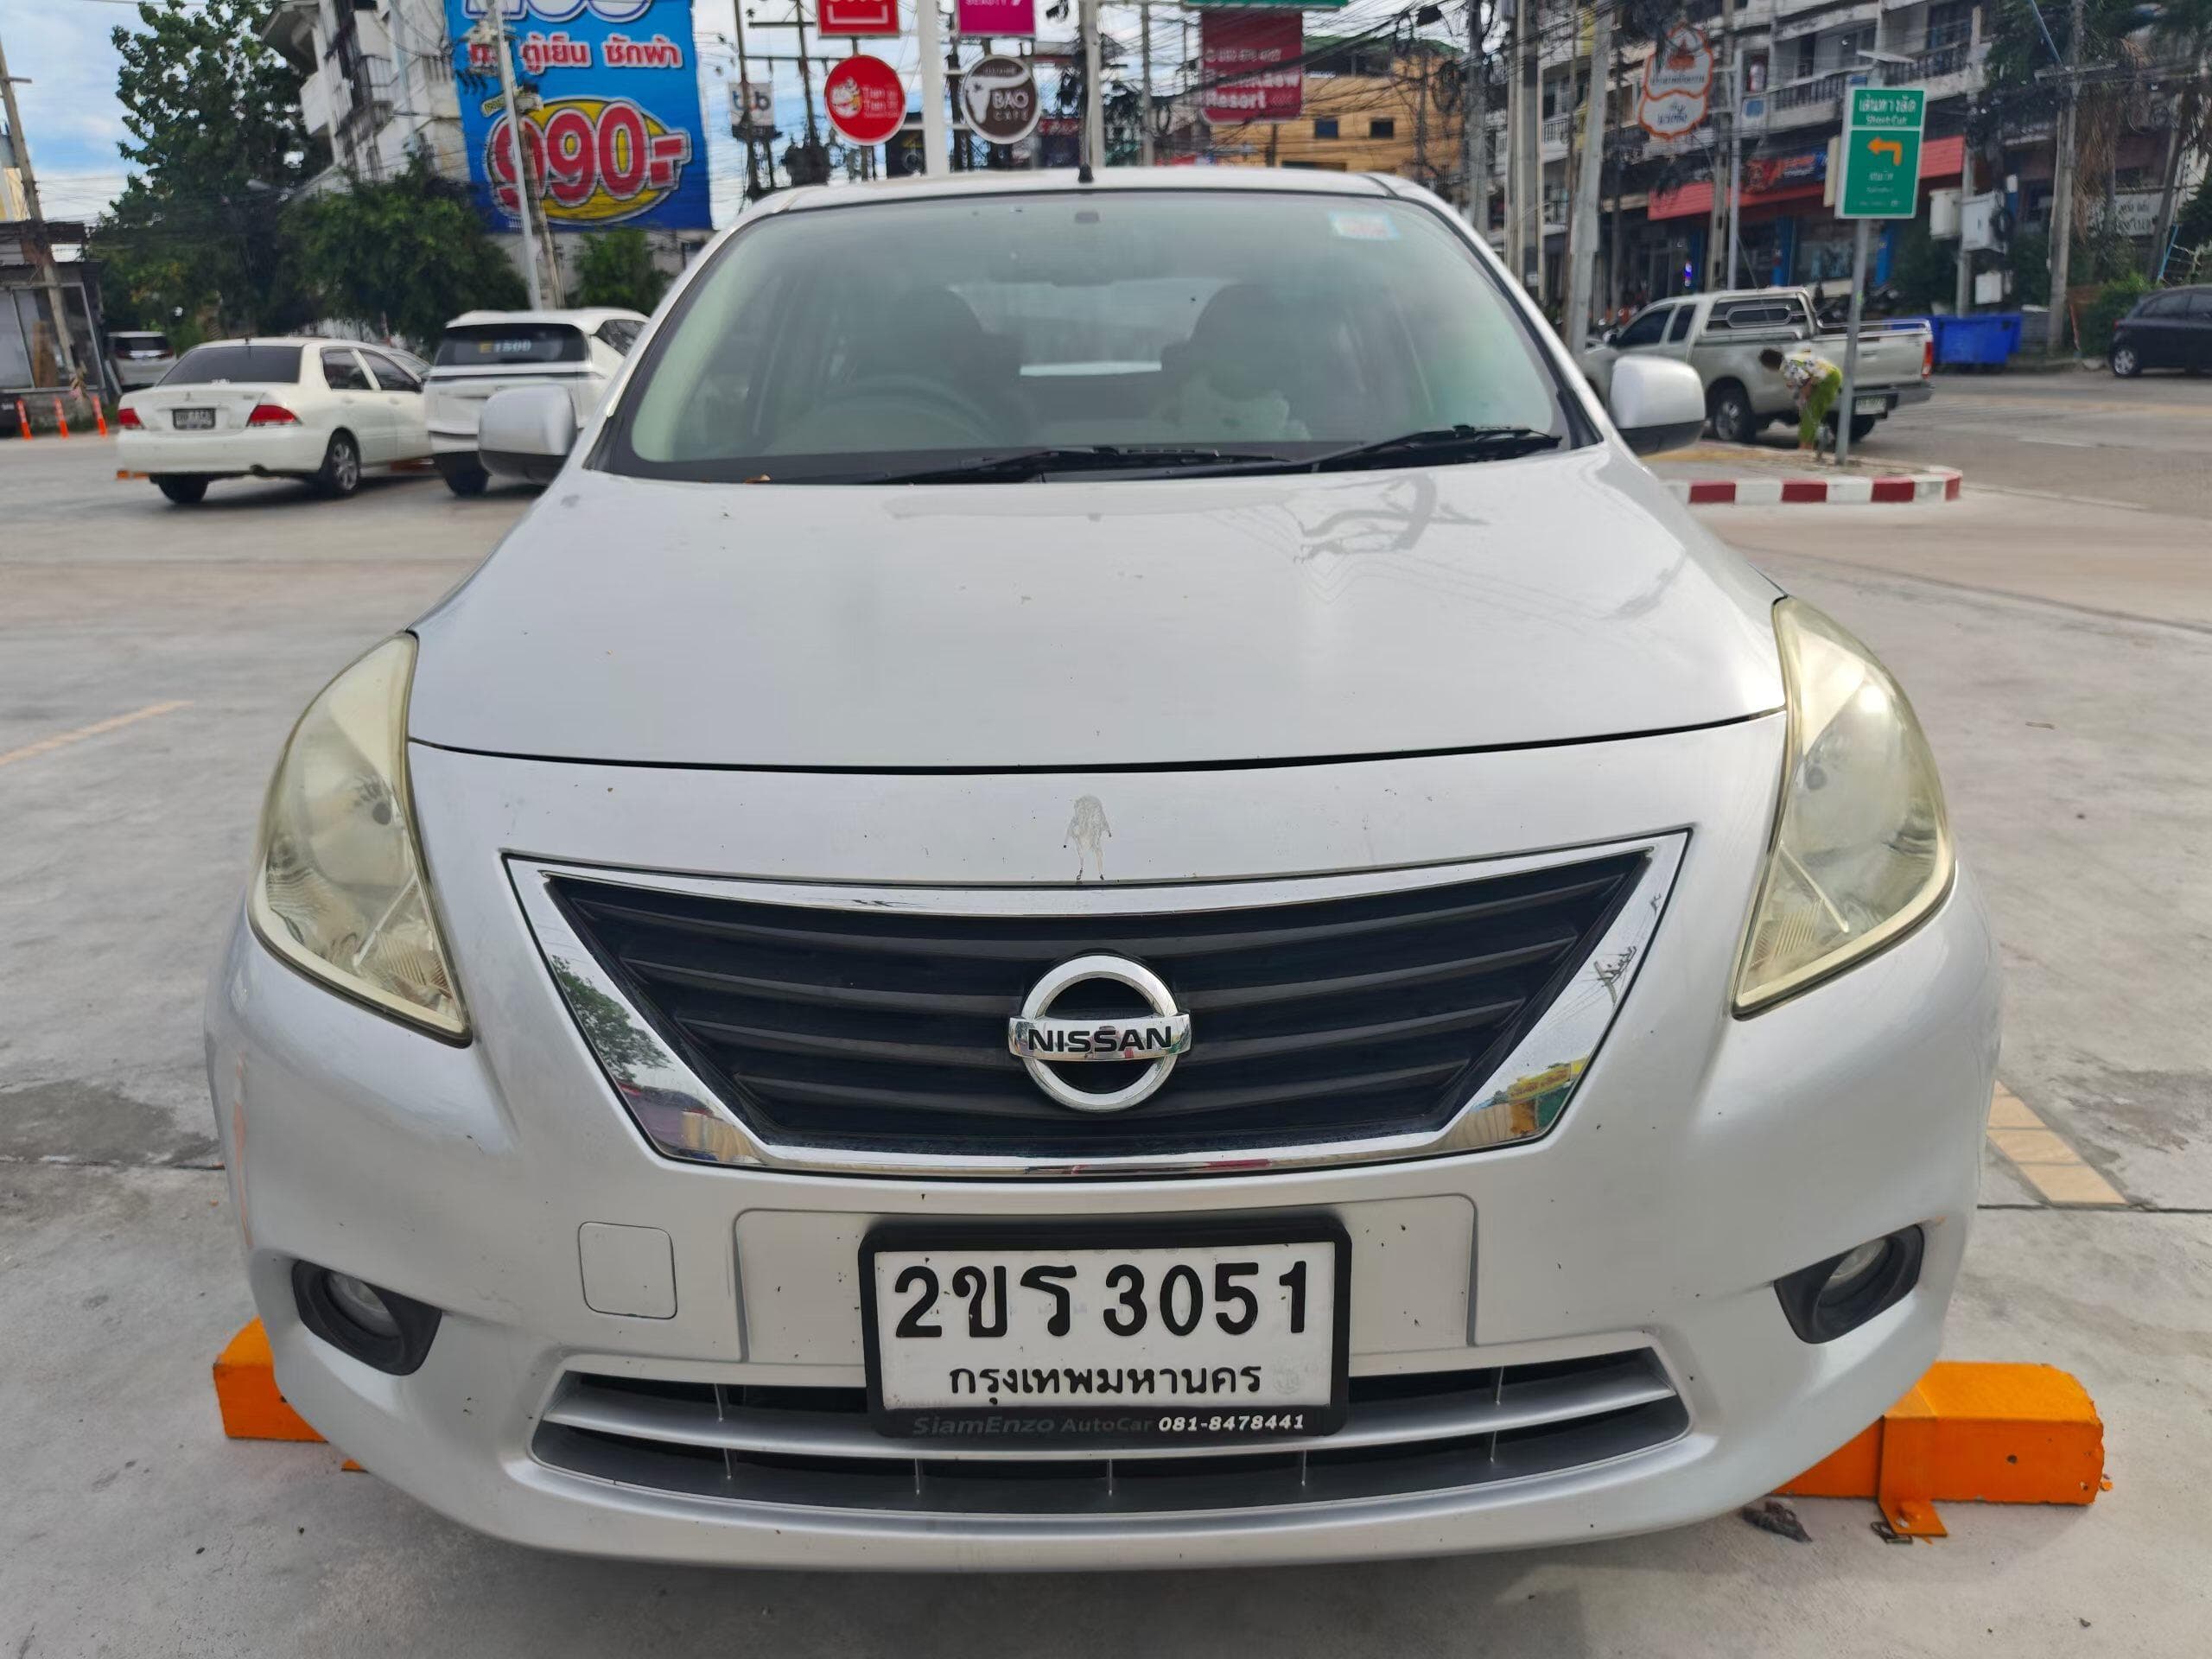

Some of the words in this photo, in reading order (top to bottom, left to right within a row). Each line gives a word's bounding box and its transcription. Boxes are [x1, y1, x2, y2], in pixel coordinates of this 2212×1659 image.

[521, 33, 589, 73] ตู้เย็น
[605, 35, 683, 66] ซักผ้า
[732, 90, 772, 111] tb
[1028, 1026, 1172, 1052] NISSAN
[894, 1265, 1077, 1338] 2ขร
[1103, 1261, 1307, 1337] 3051
[949, 1364, 1262, 1406] กรุงเทพมหานคร
[912, 1415, 1056, 1436] SiamEnzo
[1060, 1417, 1155, 1434] AutoCar
[1158, 1414, 1305, 1433] 081-8478441
